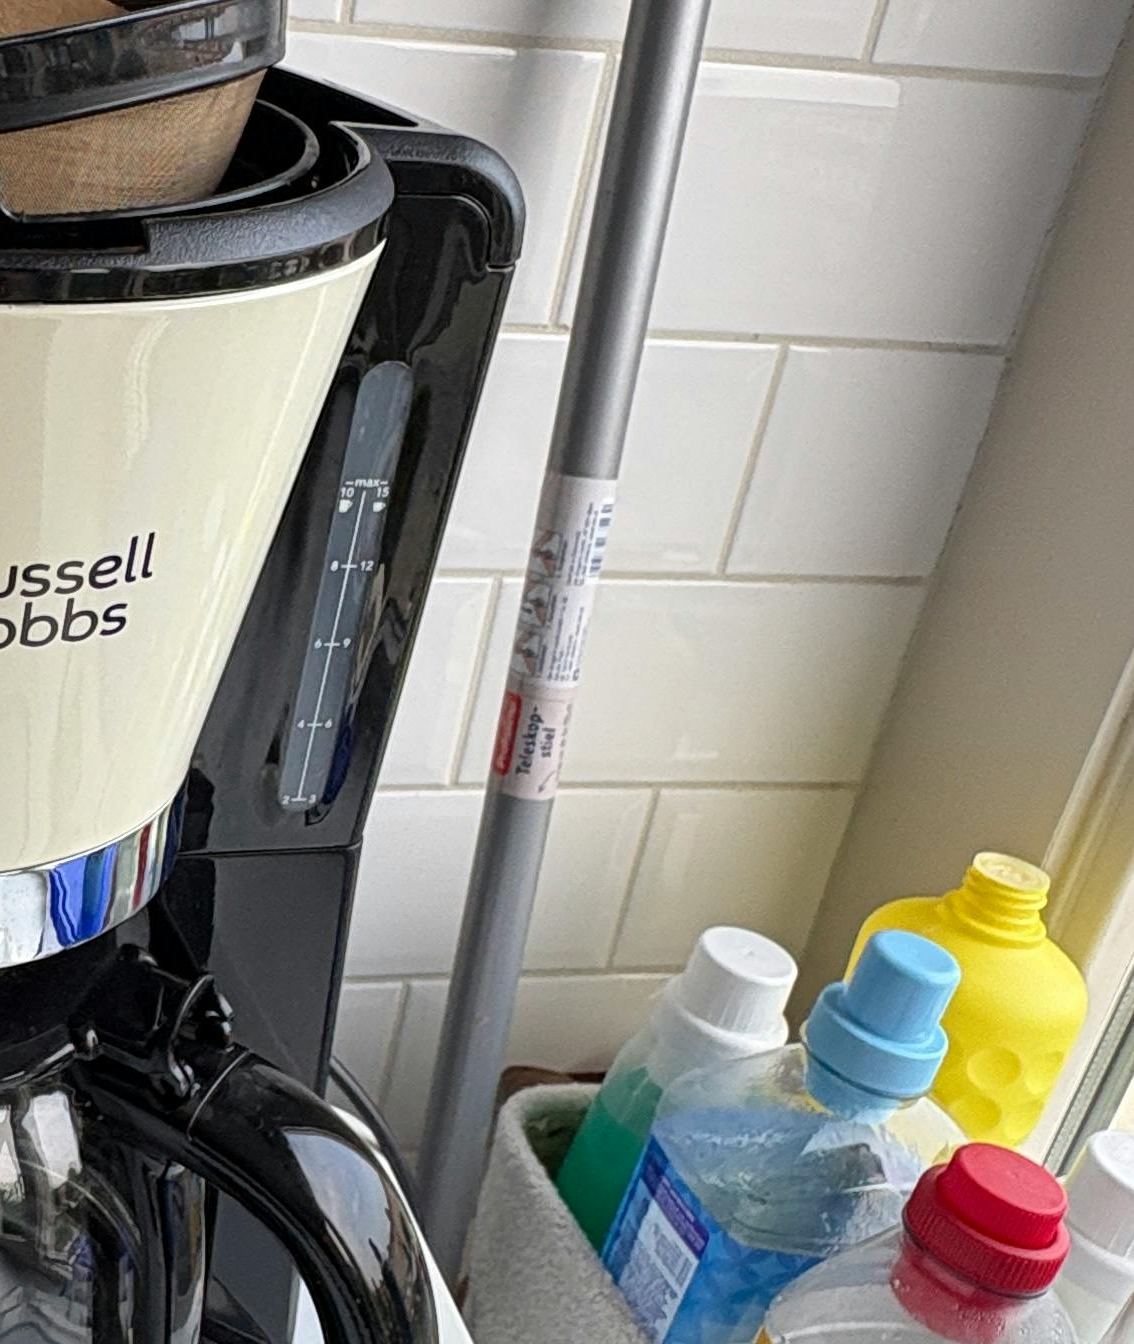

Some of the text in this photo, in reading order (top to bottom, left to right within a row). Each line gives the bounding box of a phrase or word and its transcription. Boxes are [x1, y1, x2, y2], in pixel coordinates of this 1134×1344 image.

[354, 478, 380, 488] max
[340, 487, 389, 498] 10 15
[330, 560, 374, 572] 8 12
[314, 638, 351, 649] 6 9
